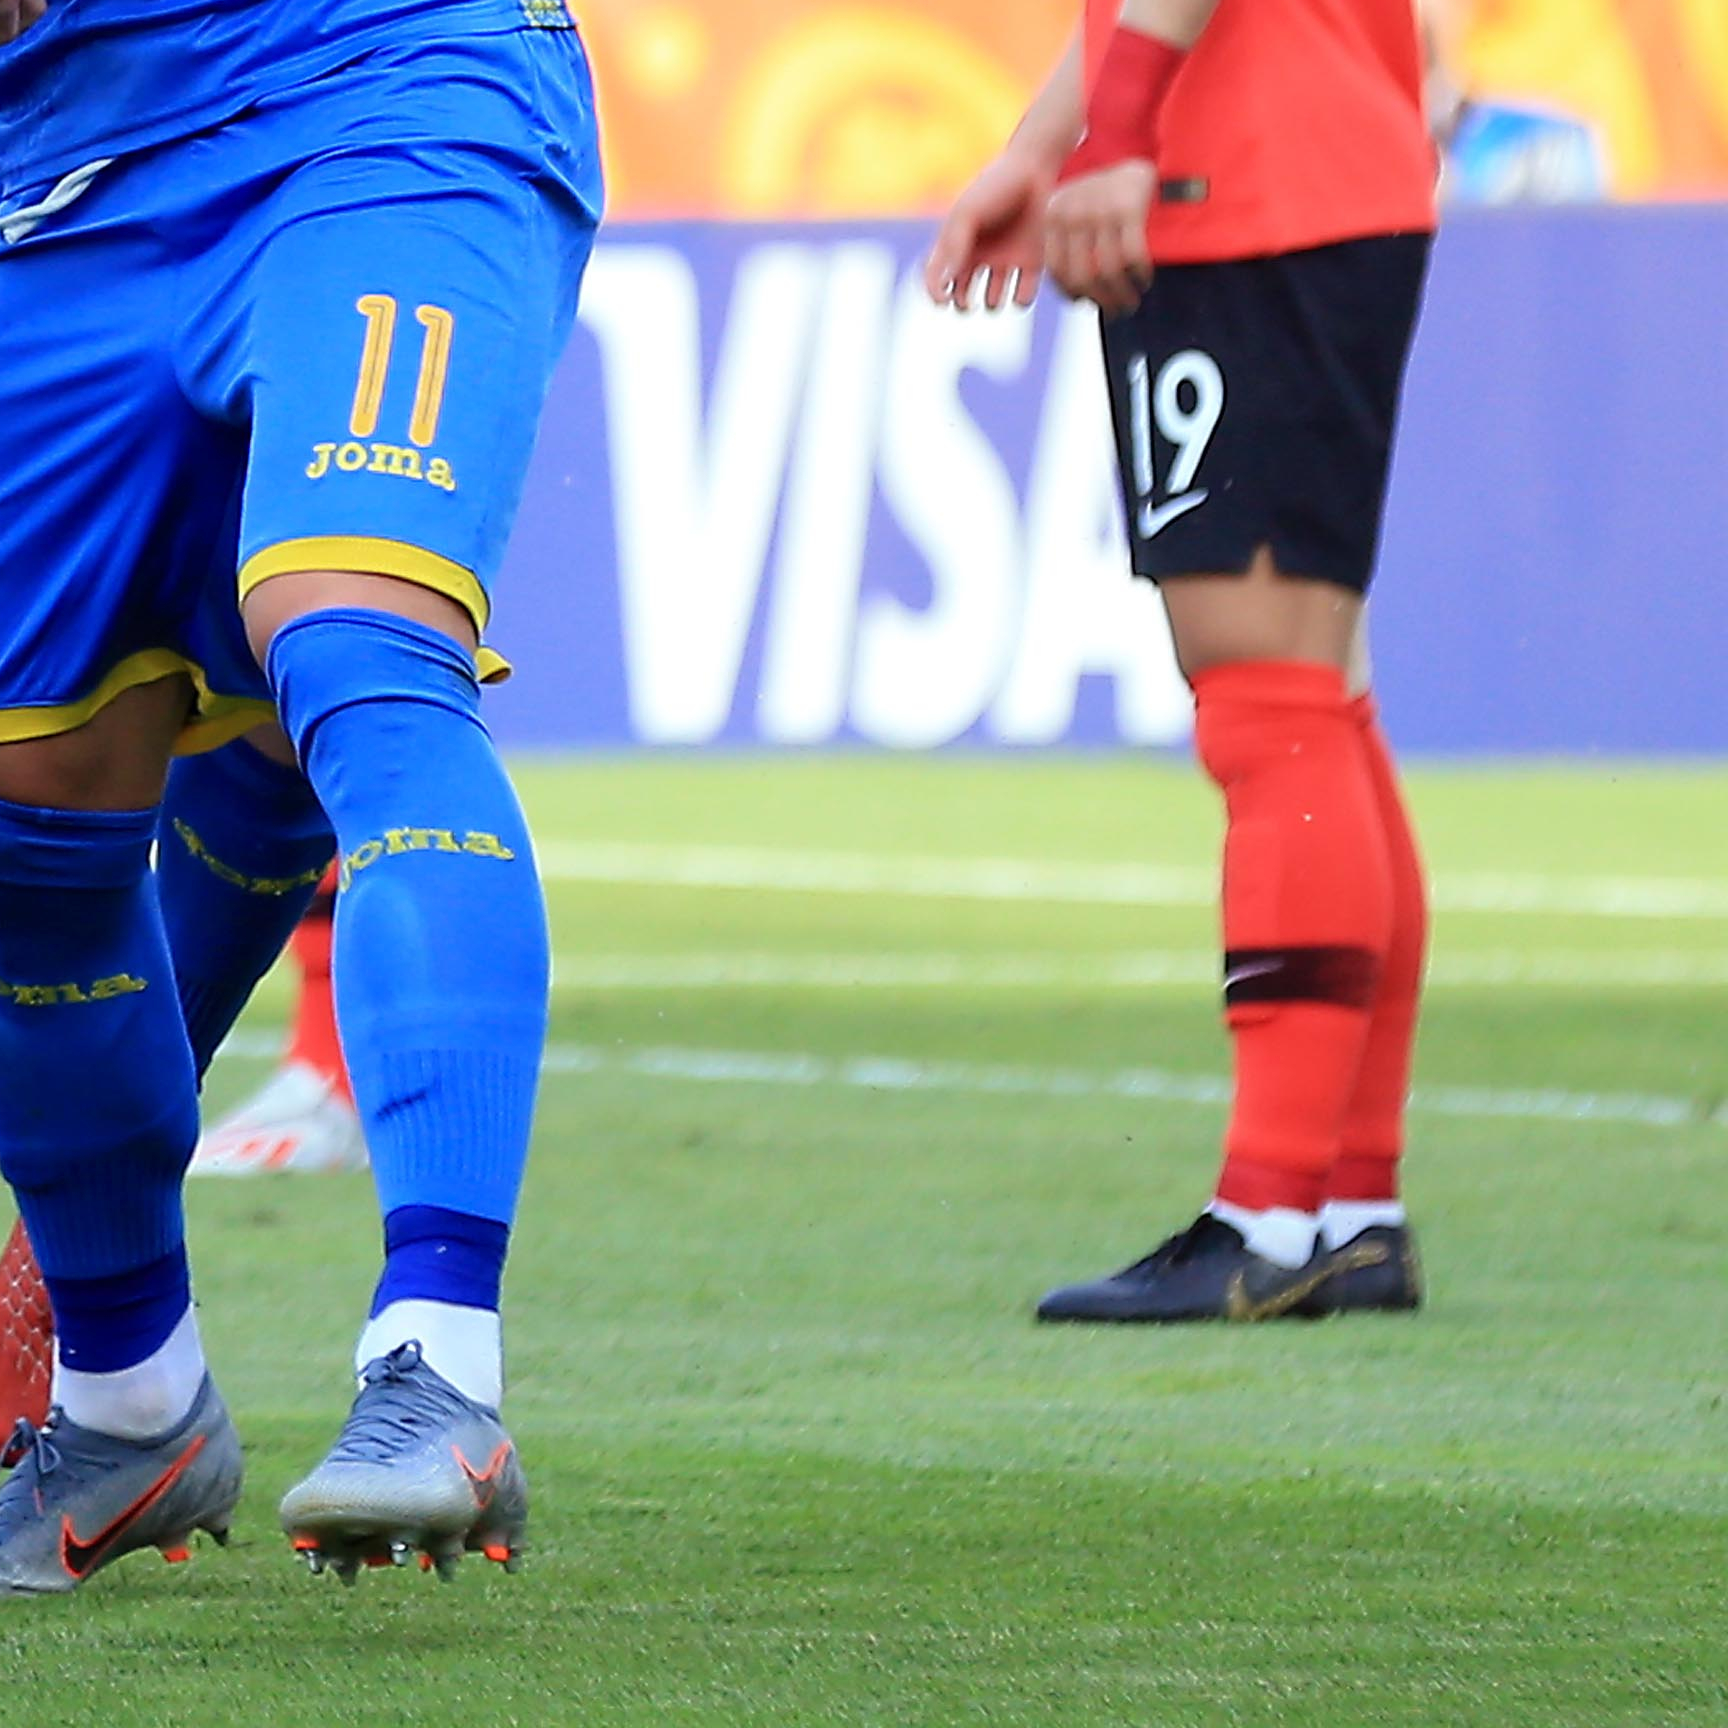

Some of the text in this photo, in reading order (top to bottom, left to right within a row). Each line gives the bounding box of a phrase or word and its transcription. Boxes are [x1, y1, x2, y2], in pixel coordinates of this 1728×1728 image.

[349, 294, 454, 448] 11
[1130, 350, 1227, 497] 19
[580, 238, 1199, 750] VISA
